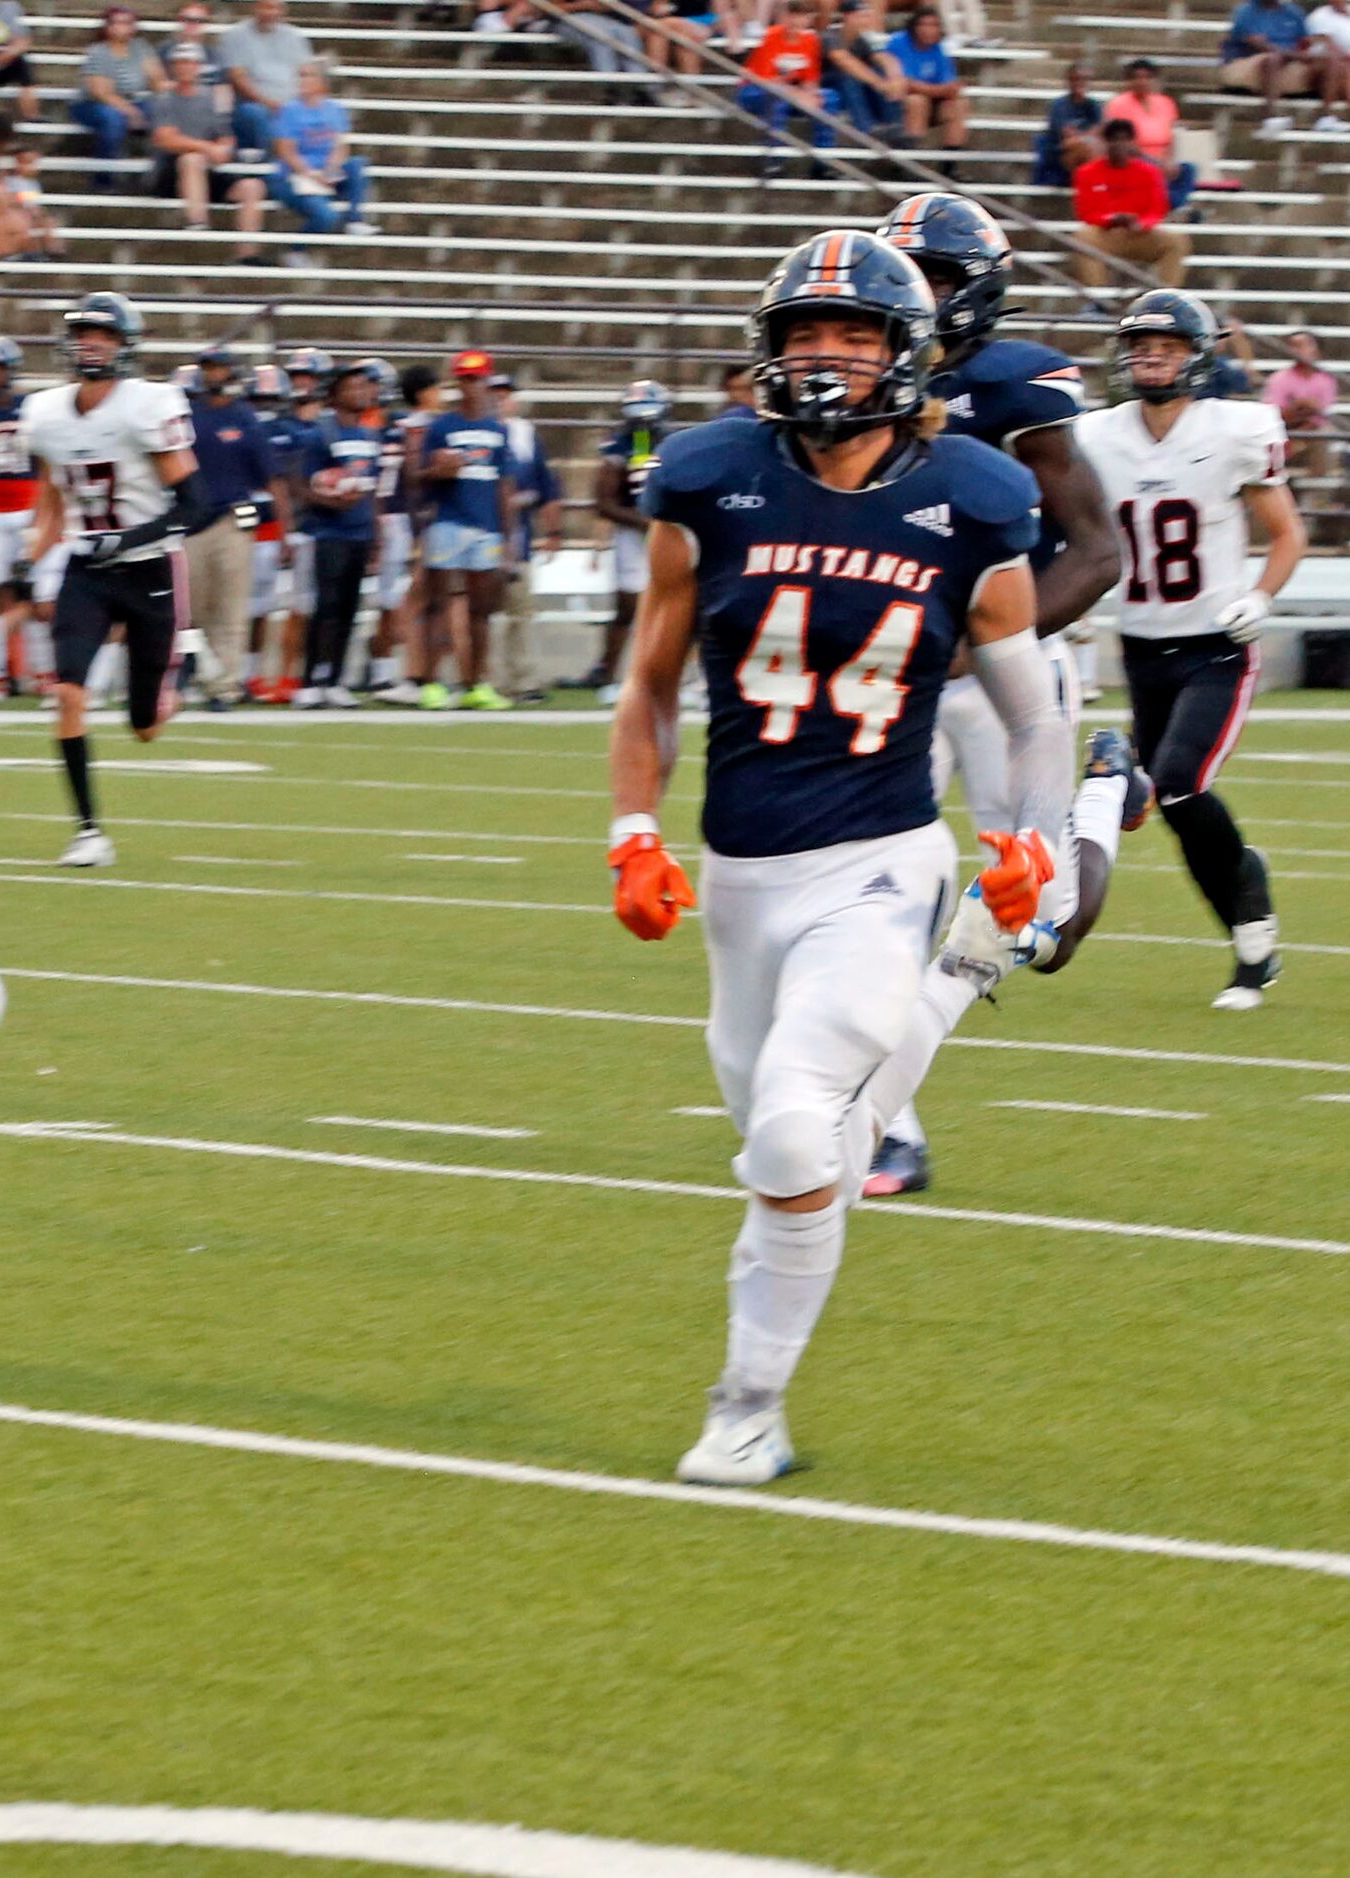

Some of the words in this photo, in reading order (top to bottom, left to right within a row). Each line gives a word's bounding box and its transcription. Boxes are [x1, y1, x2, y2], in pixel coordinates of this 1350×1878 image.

[741, 543, 944, 593] MUSTANGS
[1118, 498, 1205, 604] 18
[734, 584, 926, 757] 44
